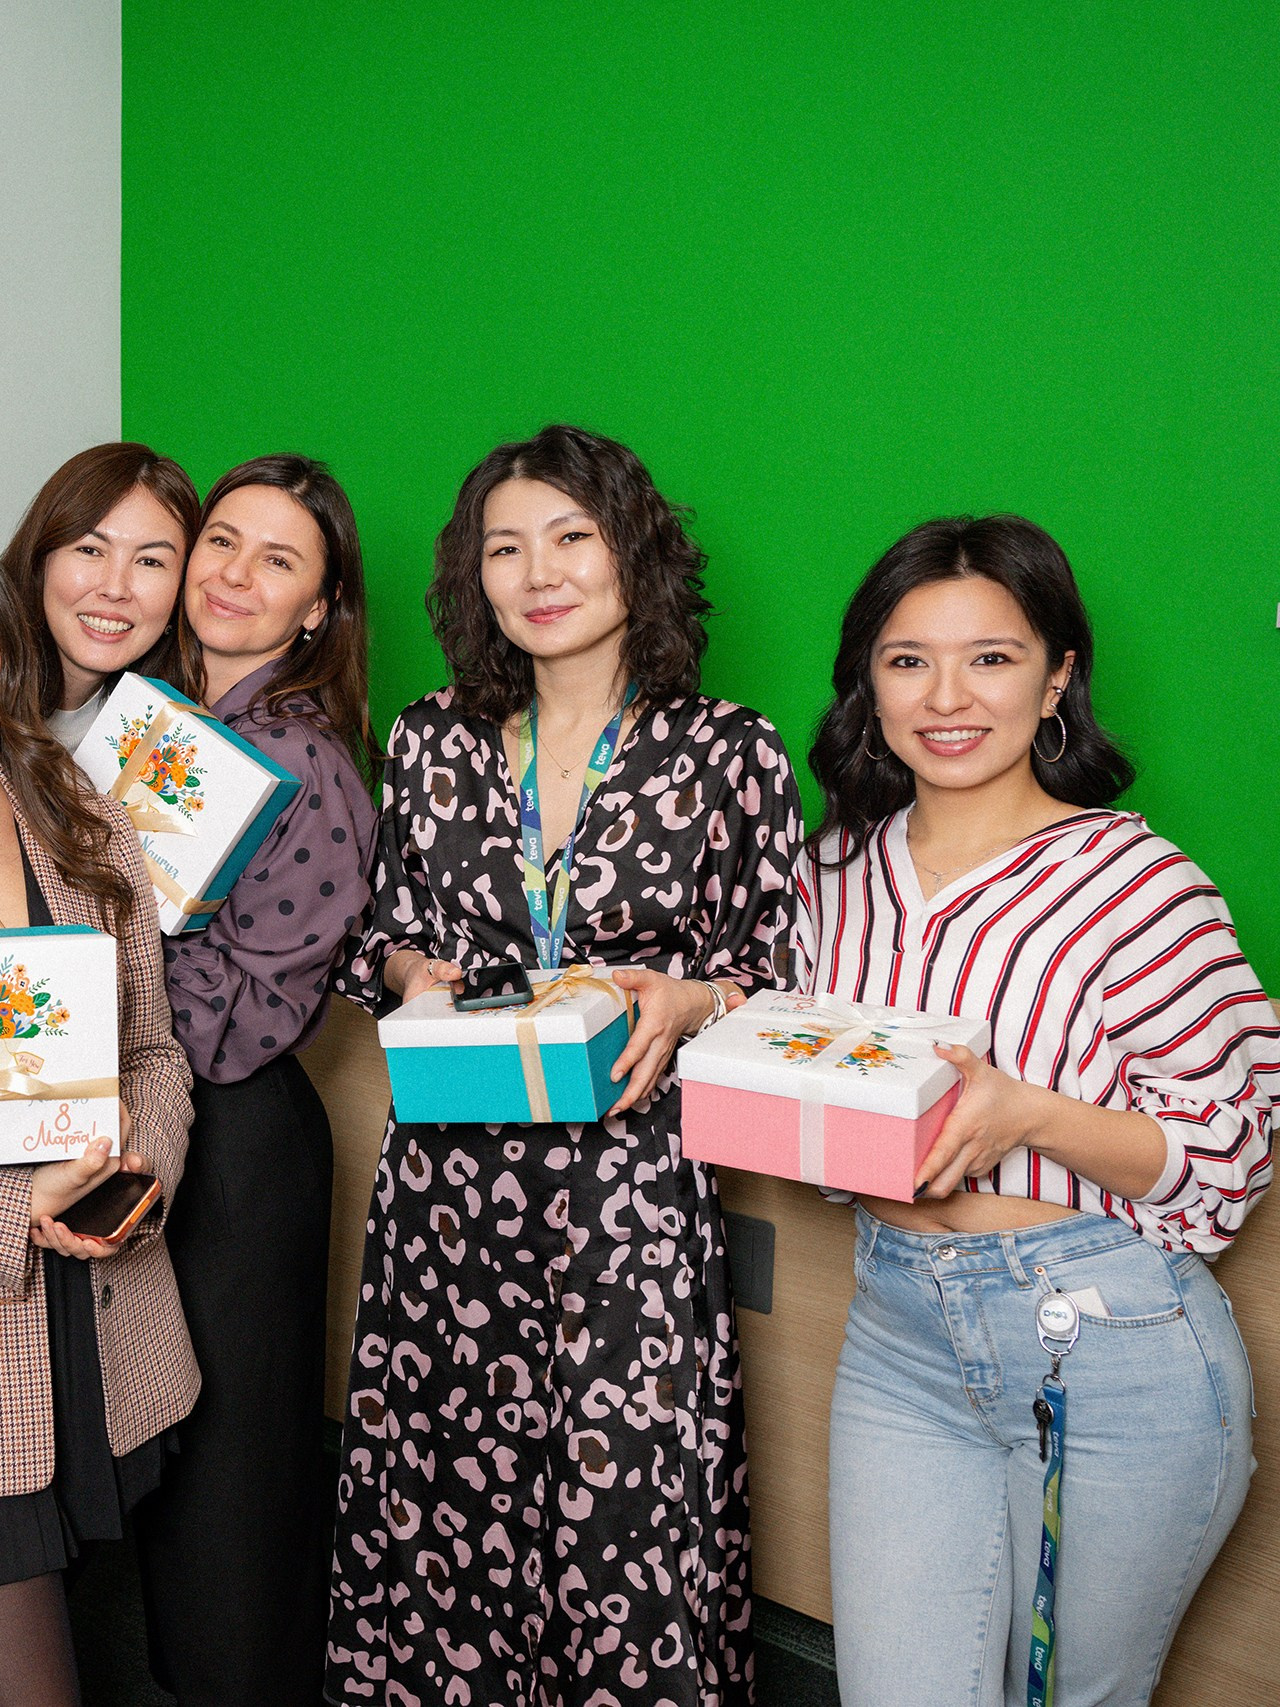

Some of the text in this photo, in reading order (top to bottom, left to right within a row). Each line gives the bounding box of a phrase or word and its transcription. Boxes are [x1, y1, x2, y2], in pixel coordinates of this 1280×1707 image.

[595, 743, 610, 765] teva
[525, 788, 534, 812] teva
[529, 837, 538, 861] teva
[534, 887, 543, 911] teva
[557, 887, 565, 912] teva
[540, 937, 548, 961] teva
[55, 1103, 71, 1132] 8
[1052, 1431, 1060, 1458] teva
[1043, 1541, 1052, 1567] teva
[1034, 1646, 1045, 1672] teva
